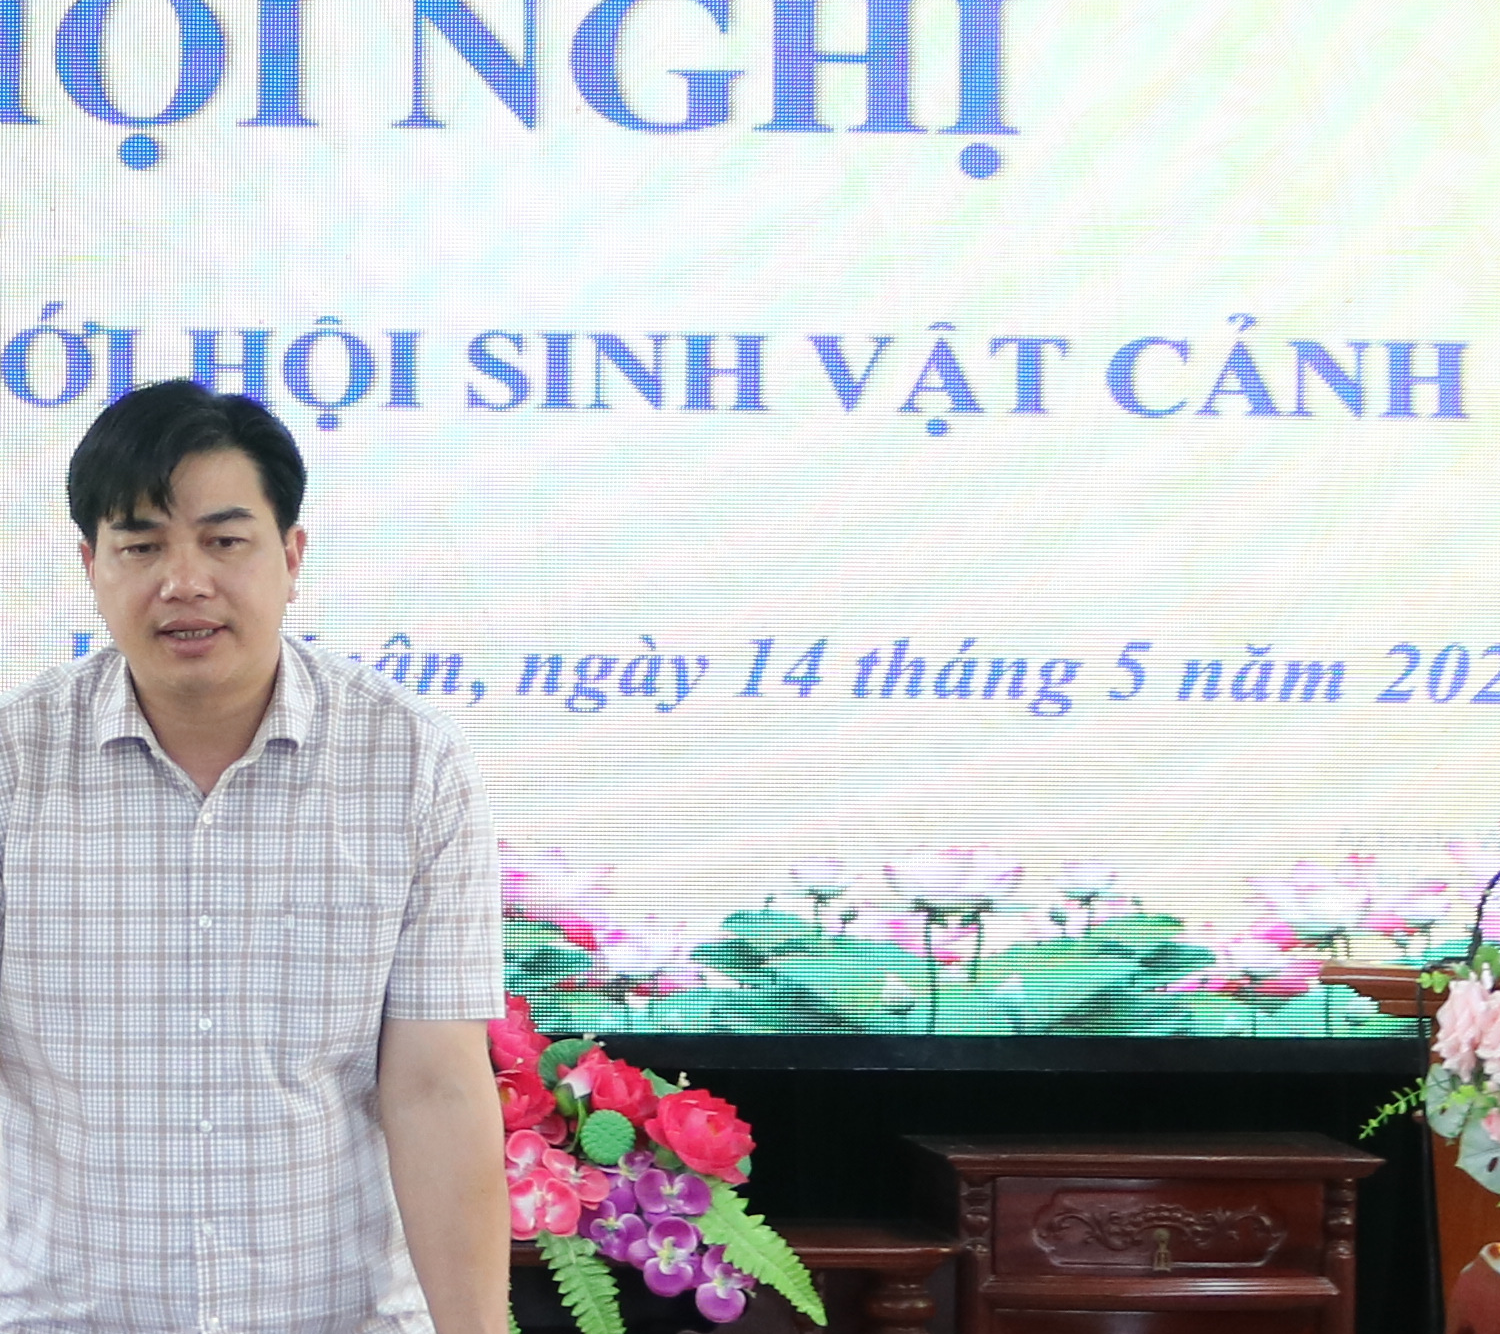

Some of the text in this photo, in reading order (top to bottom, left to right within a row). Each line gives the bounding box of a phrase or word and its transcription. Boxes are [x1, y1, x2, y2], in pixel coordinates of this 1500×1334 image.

[185, 315, 424, 434] HỘI
[466, 328, 768, 413] SINH
[809, 321, 1070, 439] VẬT
[1105, 314, 1469, 421] CẢNH
[517, 635, 709, 714] ngày
[734, 637, 828, 699] 14
[852, 638, 1083, 717] tháng
[1109, 641, 1152, 702] 5
[1176, 643, 1347, 703] năm
